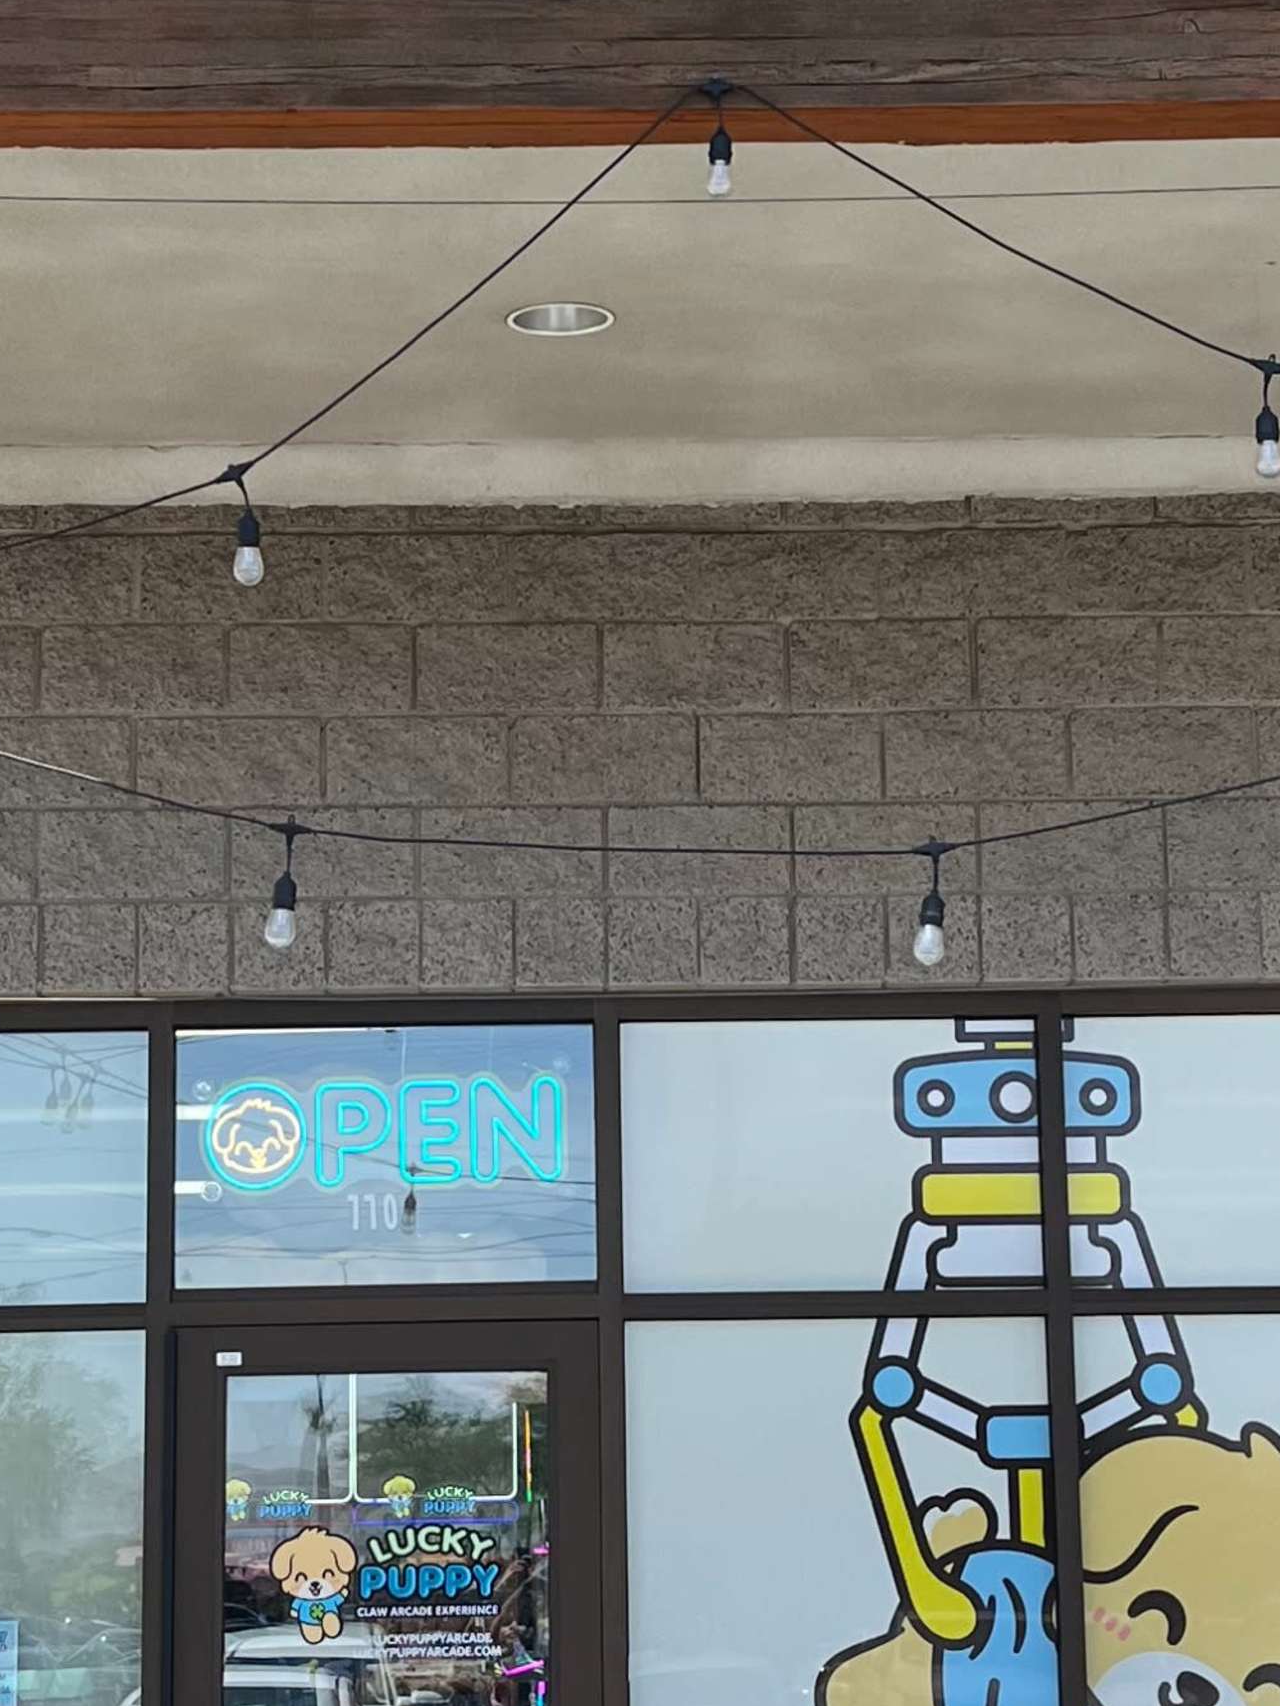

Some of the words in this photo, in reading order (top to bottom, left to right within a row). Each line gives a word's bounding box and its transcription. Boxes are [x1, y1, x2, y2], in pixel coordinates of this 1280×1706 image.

[204, 1075, 562, 1191] OPEN
[347, 1193, 398, 1230] 110
[262, 1490, 309, 1504] LUCKY
[426, 1486, 473, 1500] LUCKY
[260, 1504, 312, 1518] PUPPY
[424, 1501, 476, 1514] PUPPY
[368, 1525, 495, 1563] LUCKY
[359, 1564, 499, 1599] PUPPY
[357, 1607, 388, 1617] CLAW
[390, 1605, 433, 1617] ARCADE
[435, 1604, 498, 1616] EXPERIENCE
